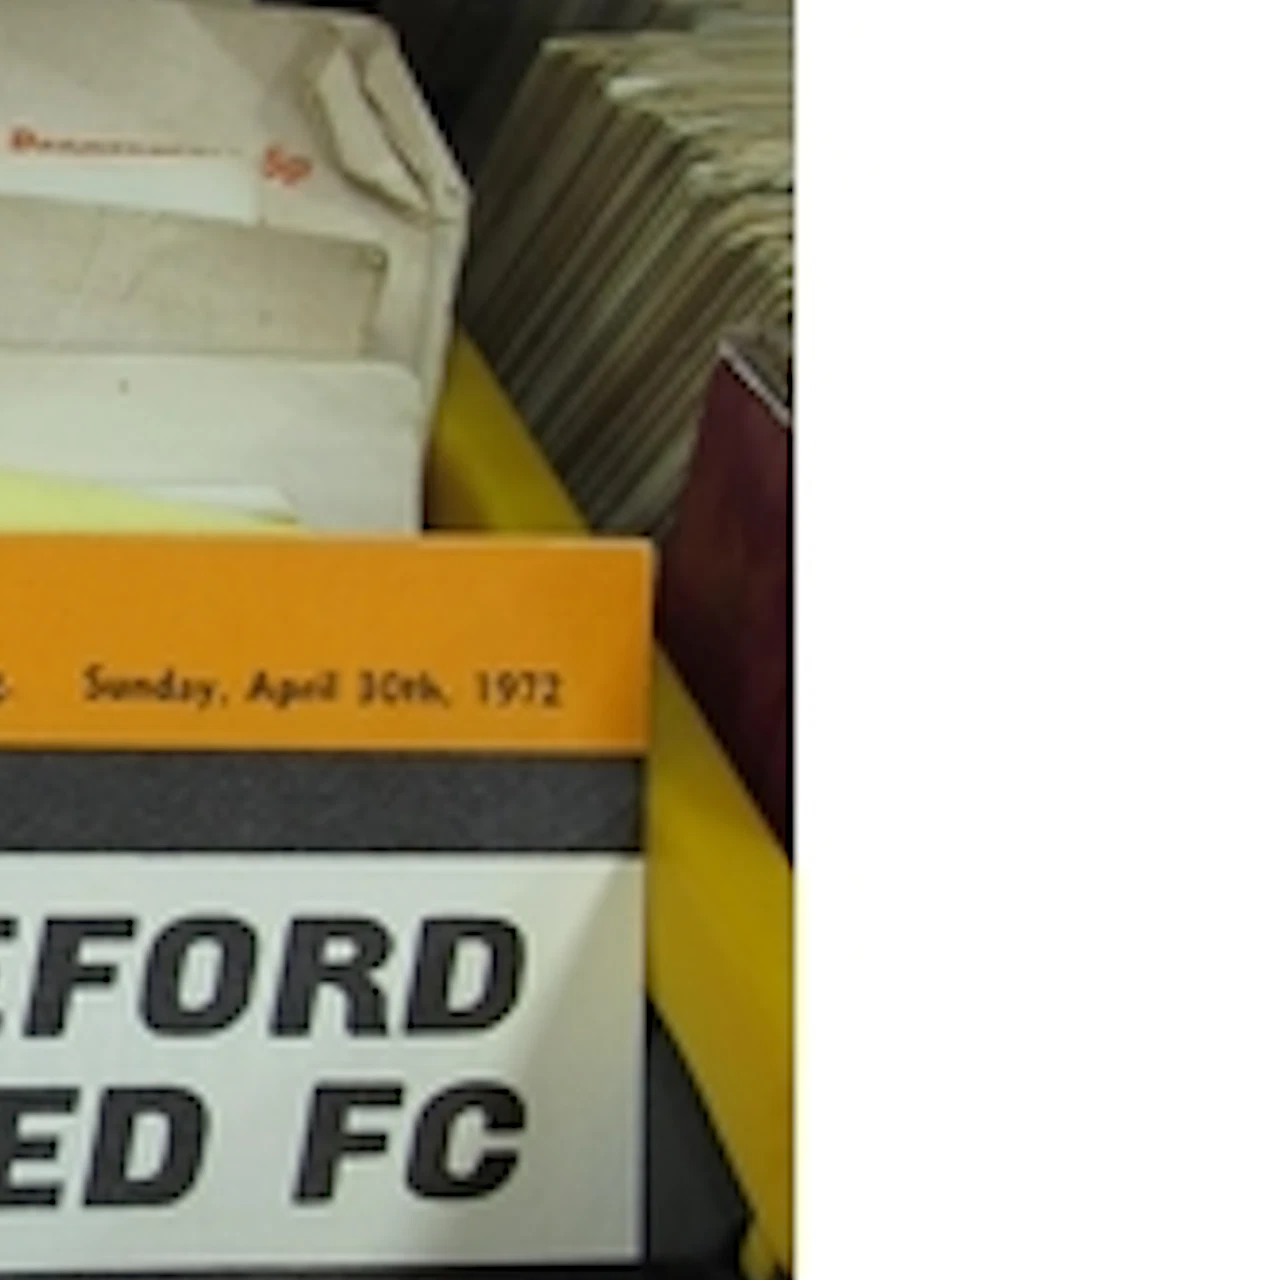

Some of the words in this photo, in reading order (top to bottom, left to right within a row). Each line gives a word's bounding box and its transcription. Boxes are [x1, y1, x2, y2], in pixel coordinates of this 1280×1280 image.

[84, 664, 228, 710] Sunday,
[245, 671, 338, 709] April
[476, 671, 563, 708] 1972
[293, 1081, 527, 1204] FC
